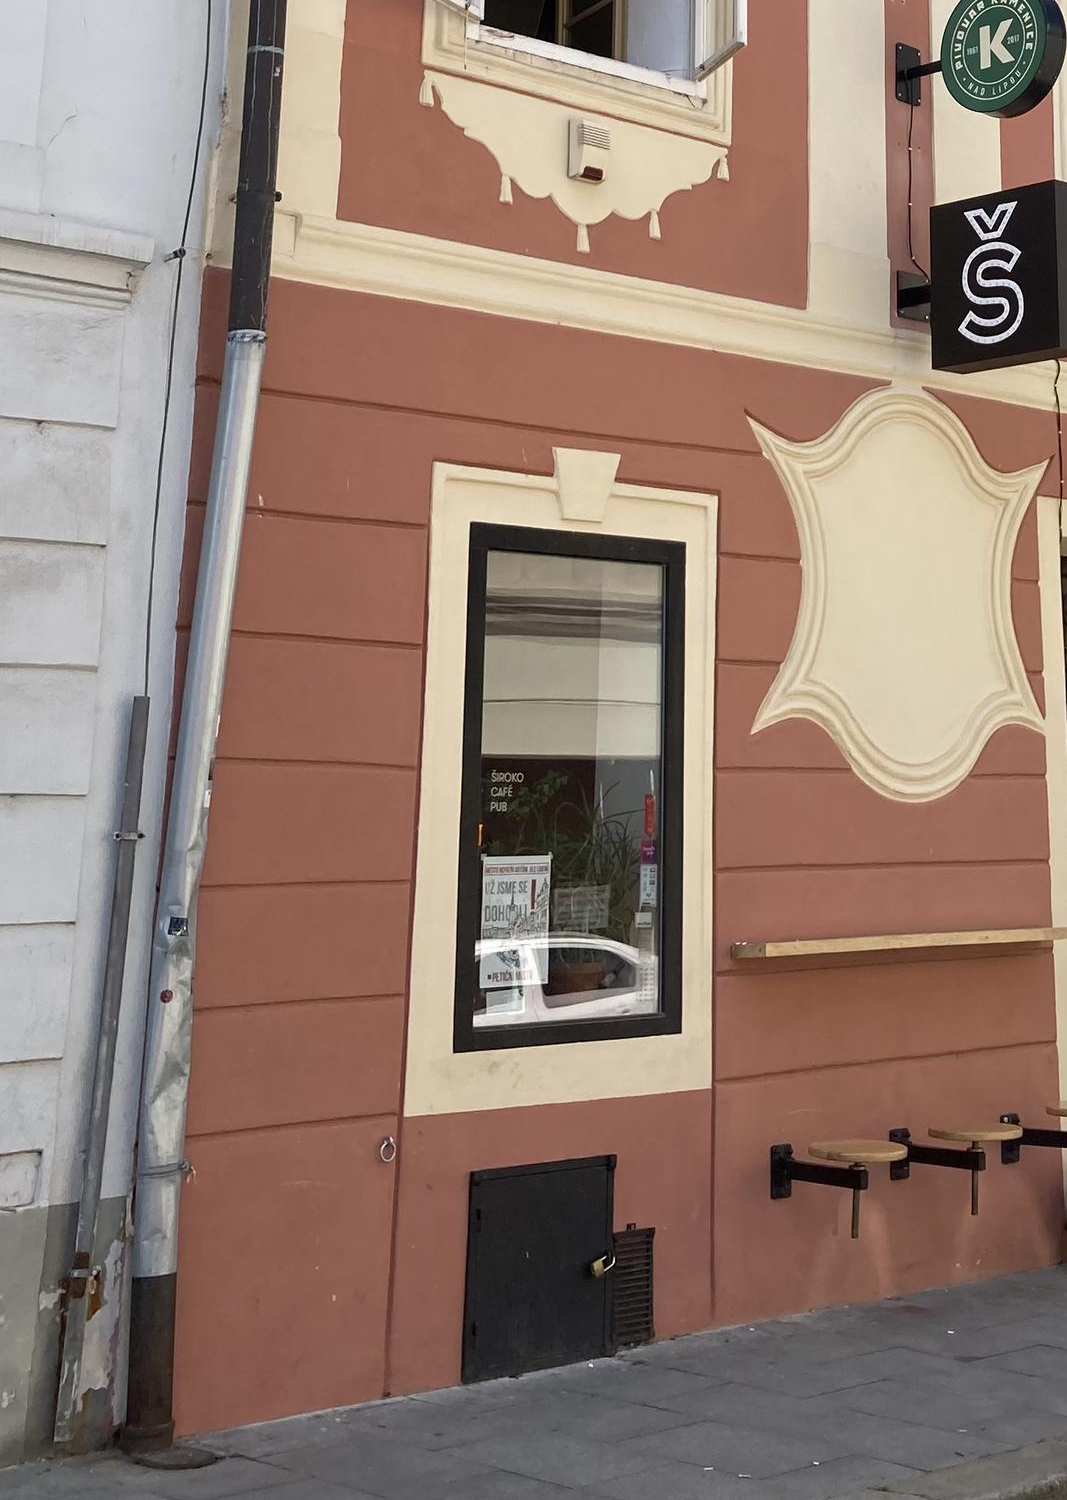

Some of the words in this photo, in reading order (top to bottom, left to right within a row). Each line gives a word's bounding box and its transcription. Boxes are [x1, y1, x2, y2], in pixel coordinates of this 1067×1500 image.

[979, 18, 1015, 70] K
[967, 82, 986, 96] NAD
[992, 70, 1022, 96] LIPOU
[491, 769, 525, 783] ŠIROKO
[490, 784, 513, 797] CAFÉ
[490, 801, 508, 812] PUB
[518, 881, 528, 893] SE
